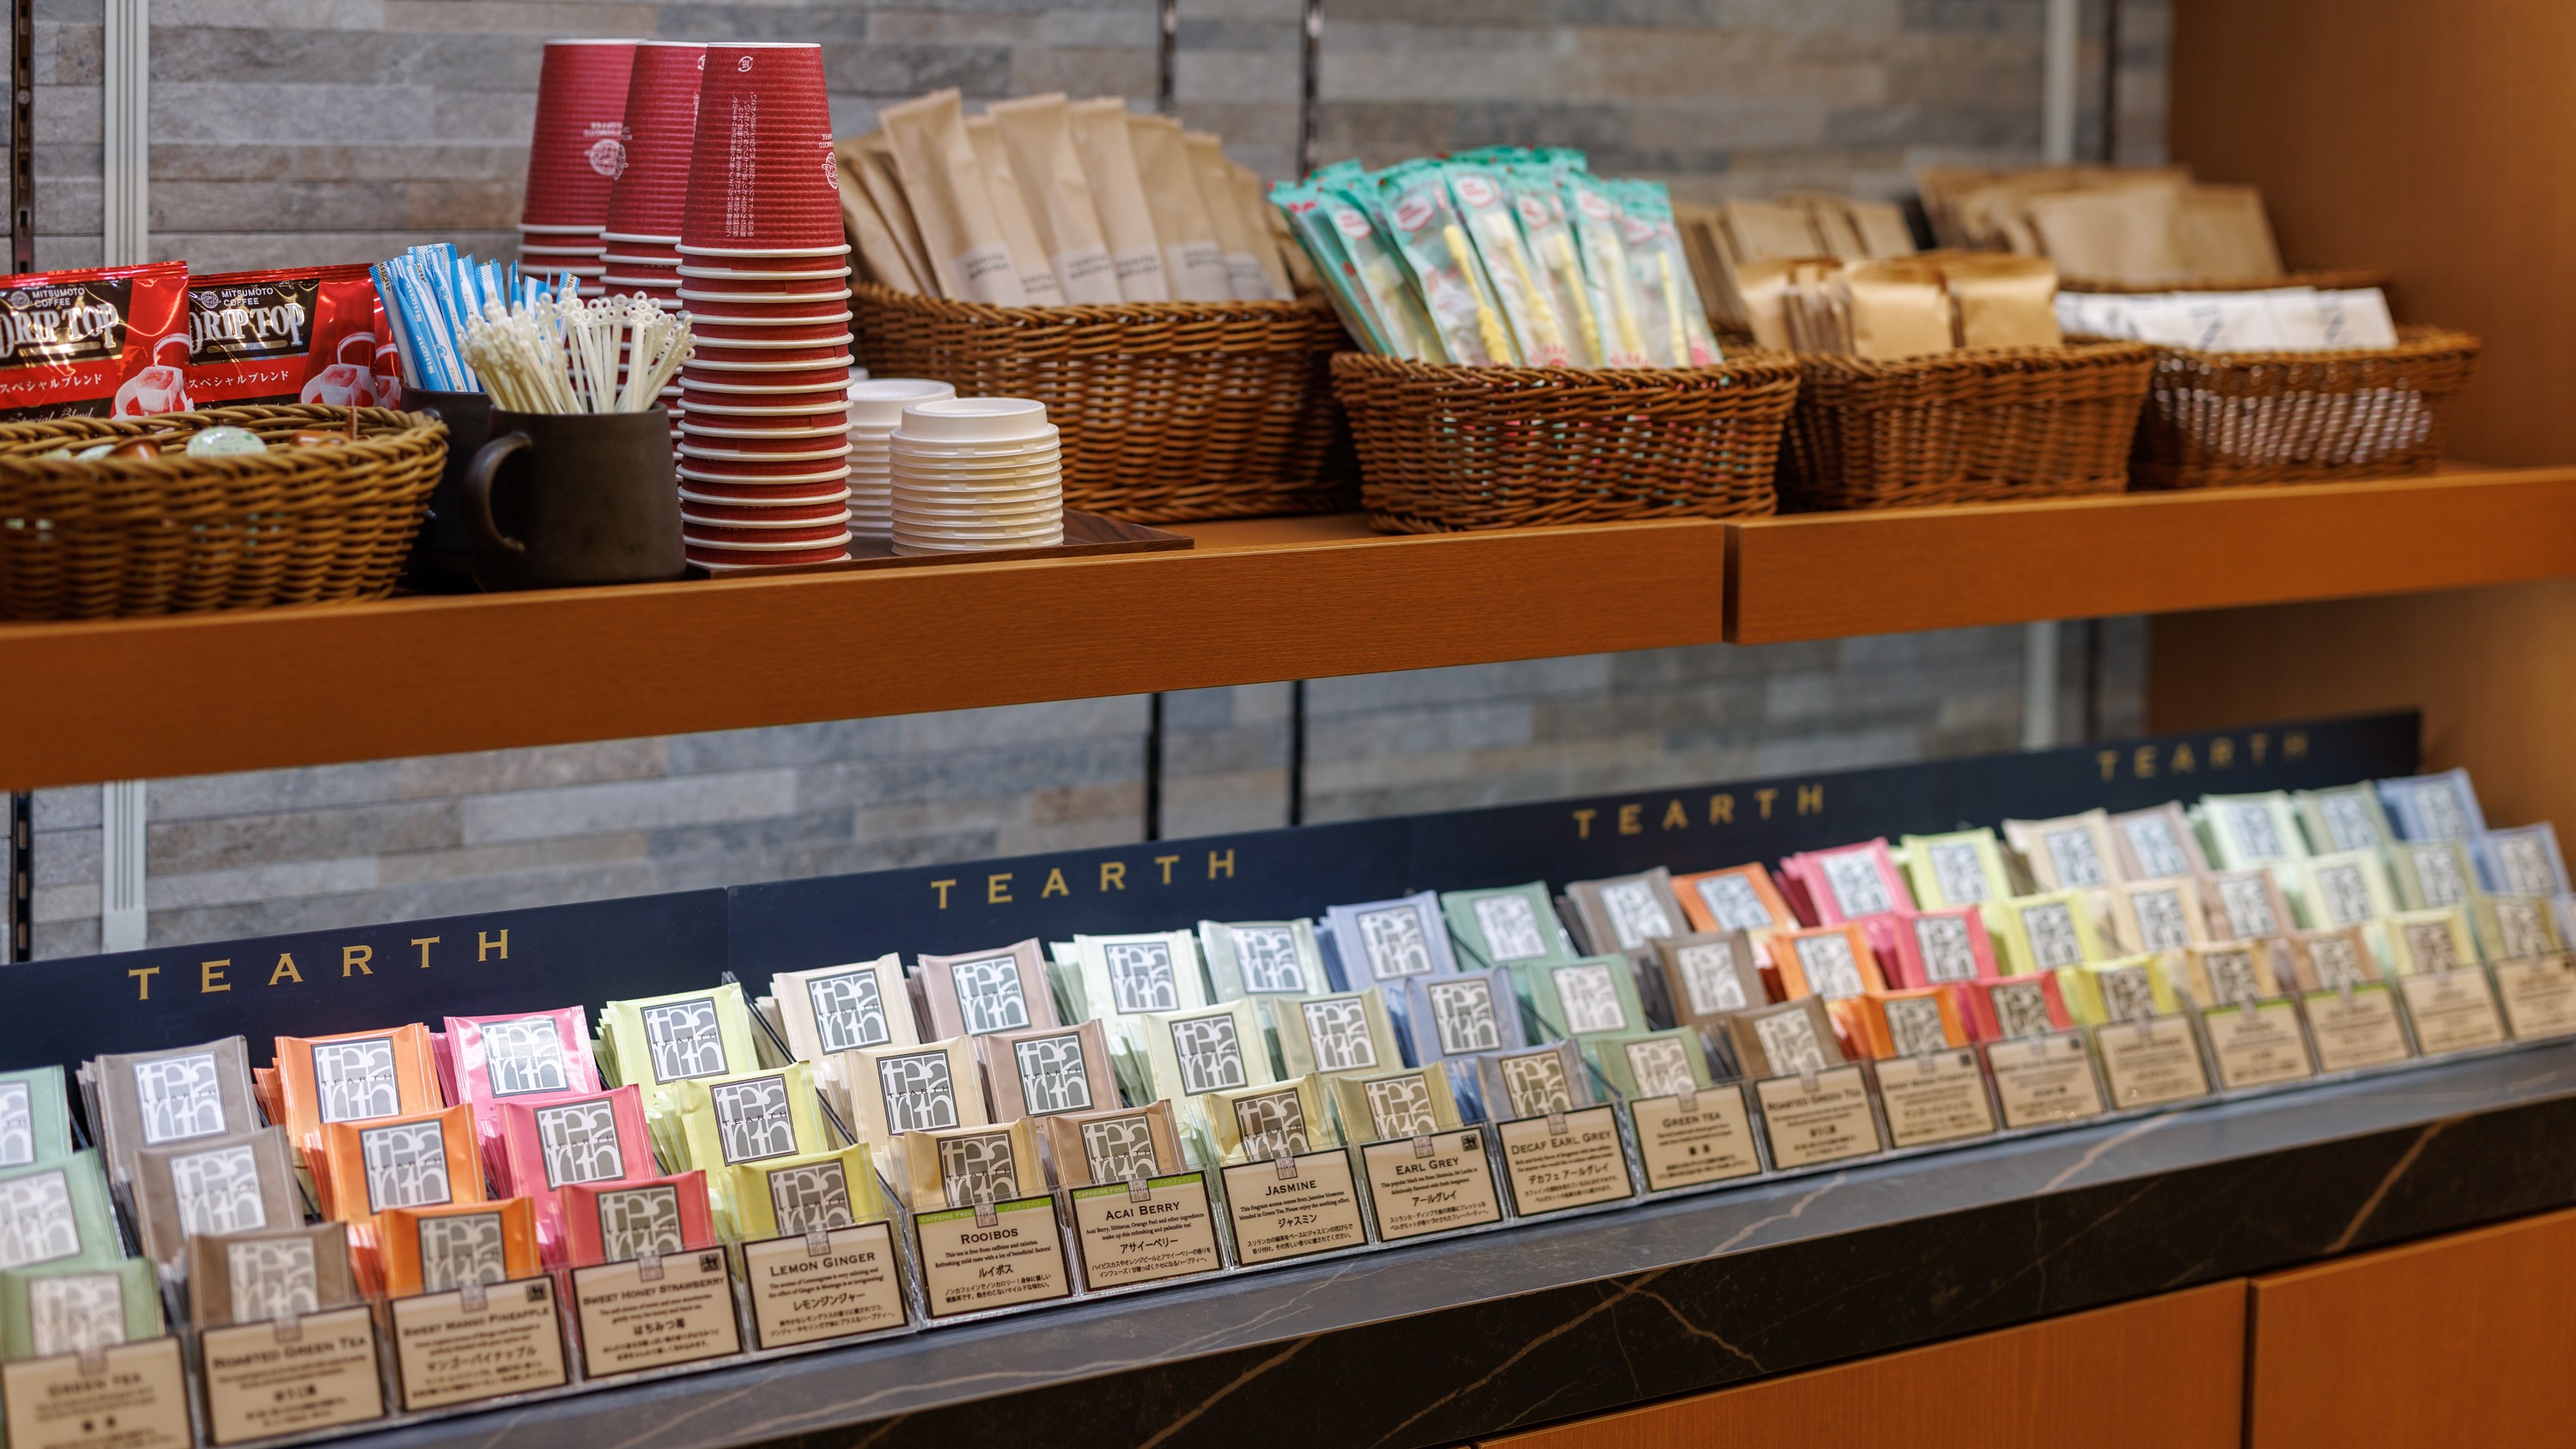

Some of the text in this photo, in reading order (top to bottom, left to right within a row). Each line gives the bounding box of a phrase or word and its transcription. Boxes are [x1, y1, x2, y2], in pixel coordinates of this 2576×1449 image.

[32, 287, 86, 299] MITSUMOTO
[221, 287, 274, 298] MITSUMOTO
[34, 298, 71, 307] COFFEE
[223, 297, 259, 306] COFFEE
[62, 304, 119, 348] TOP
[250, 302, 305, 346] TOP
[0, 373, 103, 394] スペシャルブレンド
[189, 370, 289, 389] スペシャルブレンド
[2095, 732, 2310, 783] TEARTH
[1571, 781, 1824, 840] TEARTH
[930, 848, 1235, 910] TEARTH
[128, 929, 509, 1001] TEARTH
[653, 1032, 717, 1046] TEARTH
[321, 1074, 392, 1086] TEARTH
[1024, 1067, 1082, 1080] TEARTH
[888, 1086, 949, 1098] TEARTH
[722, 1111, 788, 1126] TEARTH
[1244, 1124, 1302, 1138] TEARTH
[1510, 1140, 1547, 1155] DECAF
[1550, 1134, 1580, 1148] EARL
[1581, 1129, 1612, 1143] GREY
[1091, 1149, 1151, 1162] TEARTH
[1395, 1156, 1460, 1174] EARL GREY
[946, 1167, 1012, 1181] TEARTH
[1076, 1185, 1127, 1197] CAFFEINE FREE
[1264, 1179, 1316, 1196] JASMINE
[1412, 1190, 1457, 1206] アールグレイ
[1104, 1200, 1181, 1220] ACAI BERRY
[1250, 1203, 1268, 1211] fragrant
[1179, 1212, 1204, 1222] ingredients
[1277, 1212, 1317, 1228] ジャスミン
[960, 1227, 1018, 1245] ROOIBOS
[1131, 1228, 1153, 1237] refreshing
[1163, 1223, 1182, 1232] palatable
[1120, 1235, 1178, 1253] アサイーベリー
[769, 1250, 875, 1276] LEMON GINGER
[934, 1259, 960, 1269] Refreshing
[1012, 1247, 1034, 1256] beneficial
[793, 1289, 866, 1311] レモンジンジャー
